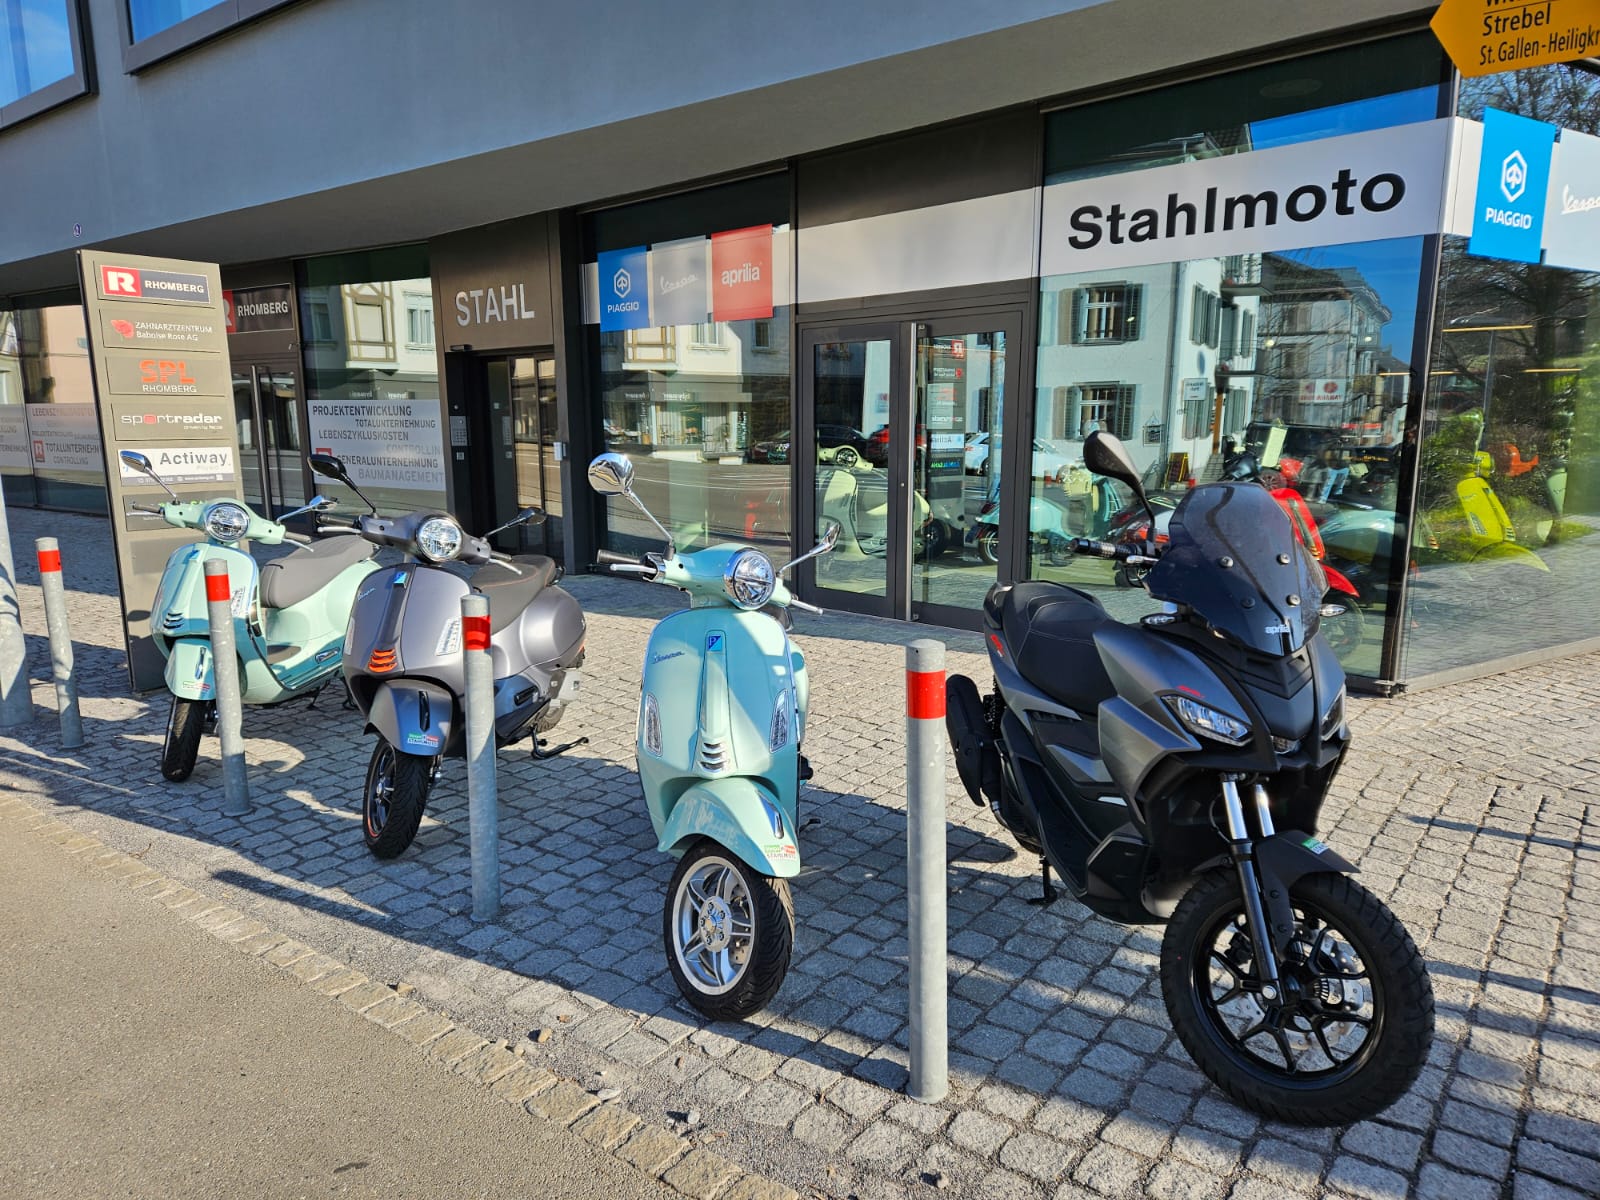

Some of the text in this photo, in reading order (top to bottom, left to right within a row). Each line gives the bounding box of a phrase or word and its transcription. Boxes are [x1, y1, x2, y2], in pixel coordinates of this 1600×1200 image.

[1482, 3, 1551, 36] Strebel
[1067, 169, 1406, 249] Stahlmoto
[1485, 207, 1532, 229] PIAGGIO
[721, 263, 760, 287] aprilia
[144, 280, 205, 293] RHOMBERG
[660, 274, 698, 295] Vespa
[237, 301, 288, 317] RHOMBERG
[456, 283, 535, 327] STAHL
[607, 301, 640, 313] PIAGGIO
[135, 321, 213, 333] ZAHNARZTZENTRUM
[140, 359, 196, 384] SPL
[142, 384, 197, 393] RHOMBERG
[312, 405, 412, 416] PROJEKTENTWICKLUNG
[121, 413, 222, 426] sportradar
[355, 419, 436, 428] TOTALUNTERNEHMUNG
[319, 429, 409, 440] LEBENSZYKLUSKOSTEN
[160, 452, 227, 466] Actiway
[359, 468, 444, 482] BAUMANAGEMENT
[1264, 624, 1290, 634] aprilia
